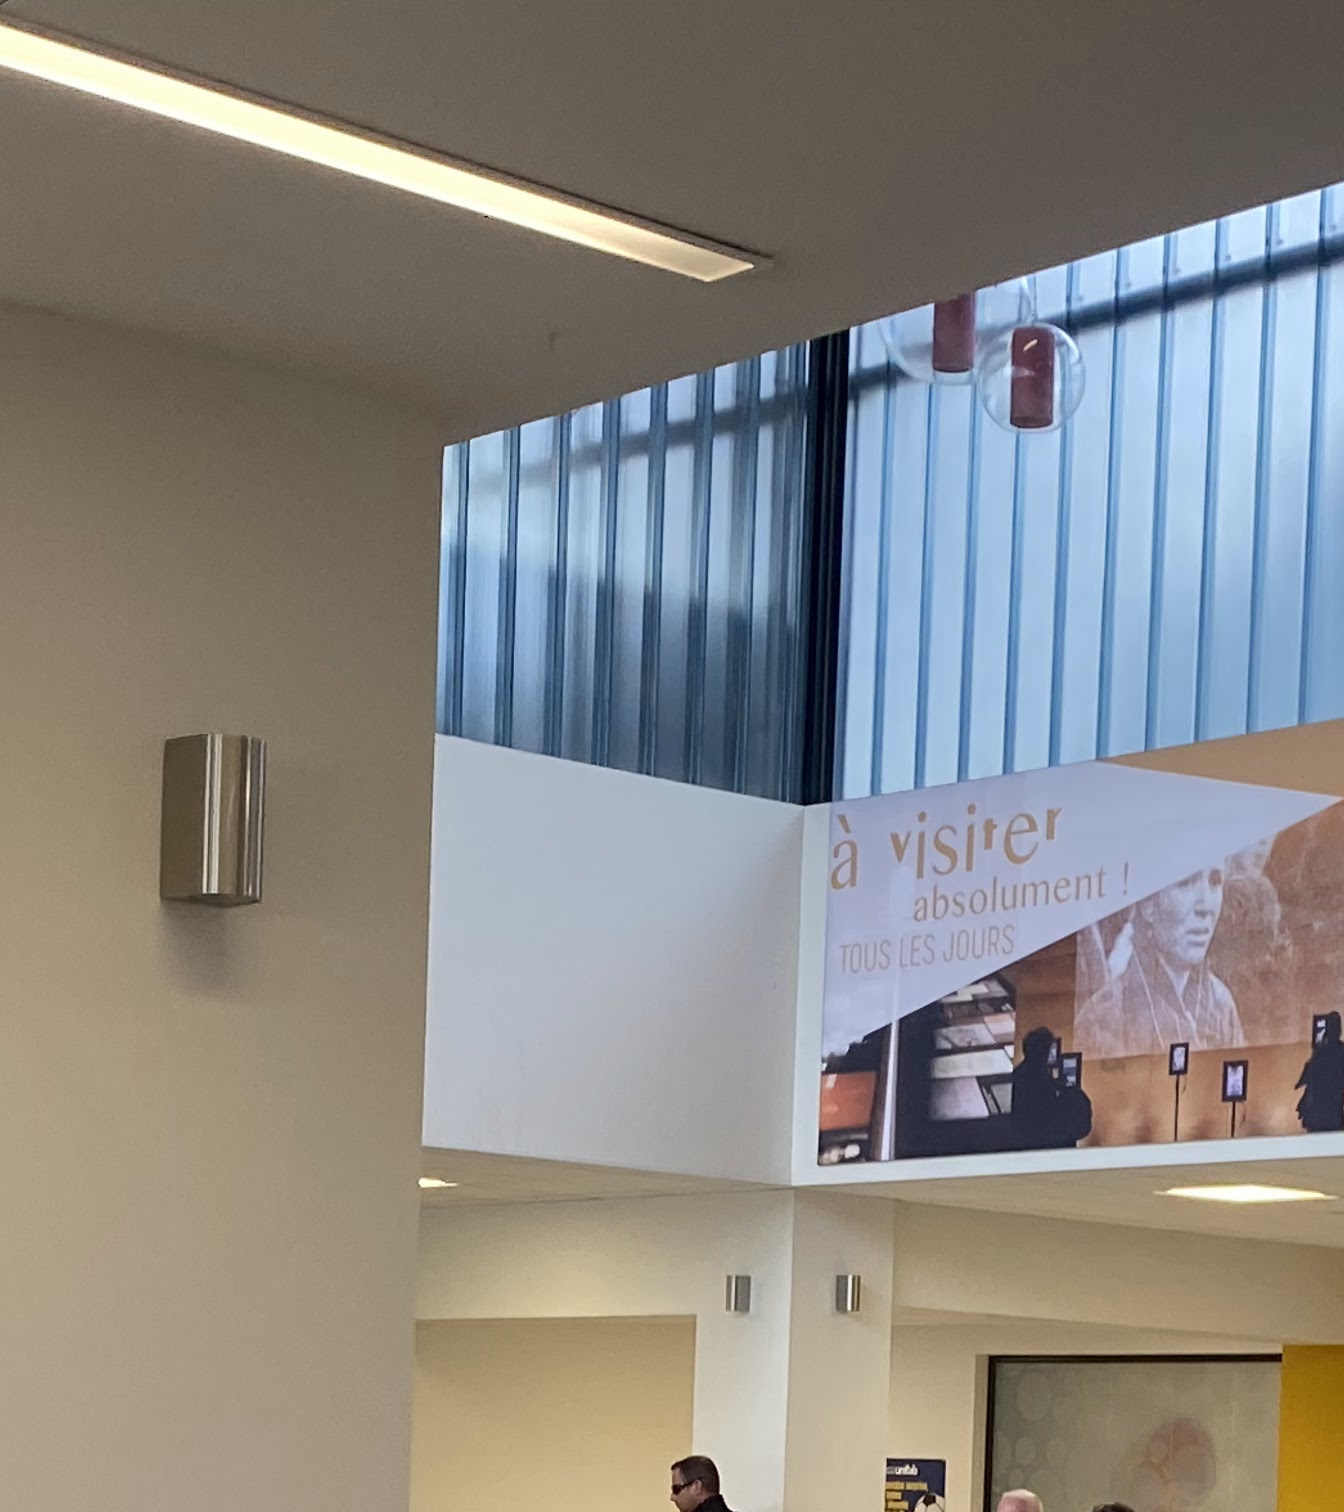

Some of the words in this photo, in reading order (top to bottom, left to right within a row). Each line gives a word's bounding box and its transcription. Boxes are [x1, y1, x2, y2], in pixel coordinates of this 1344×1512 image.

[830, 814, 859, 891] à
[889, 803, 1063, 880] visiter
[912, 864, 1108, 923] absolument
[839, 940, 891, 975] TOUS
[898, 933, 936, 969] LES
[942, 923, 1017, 963] JOURS
